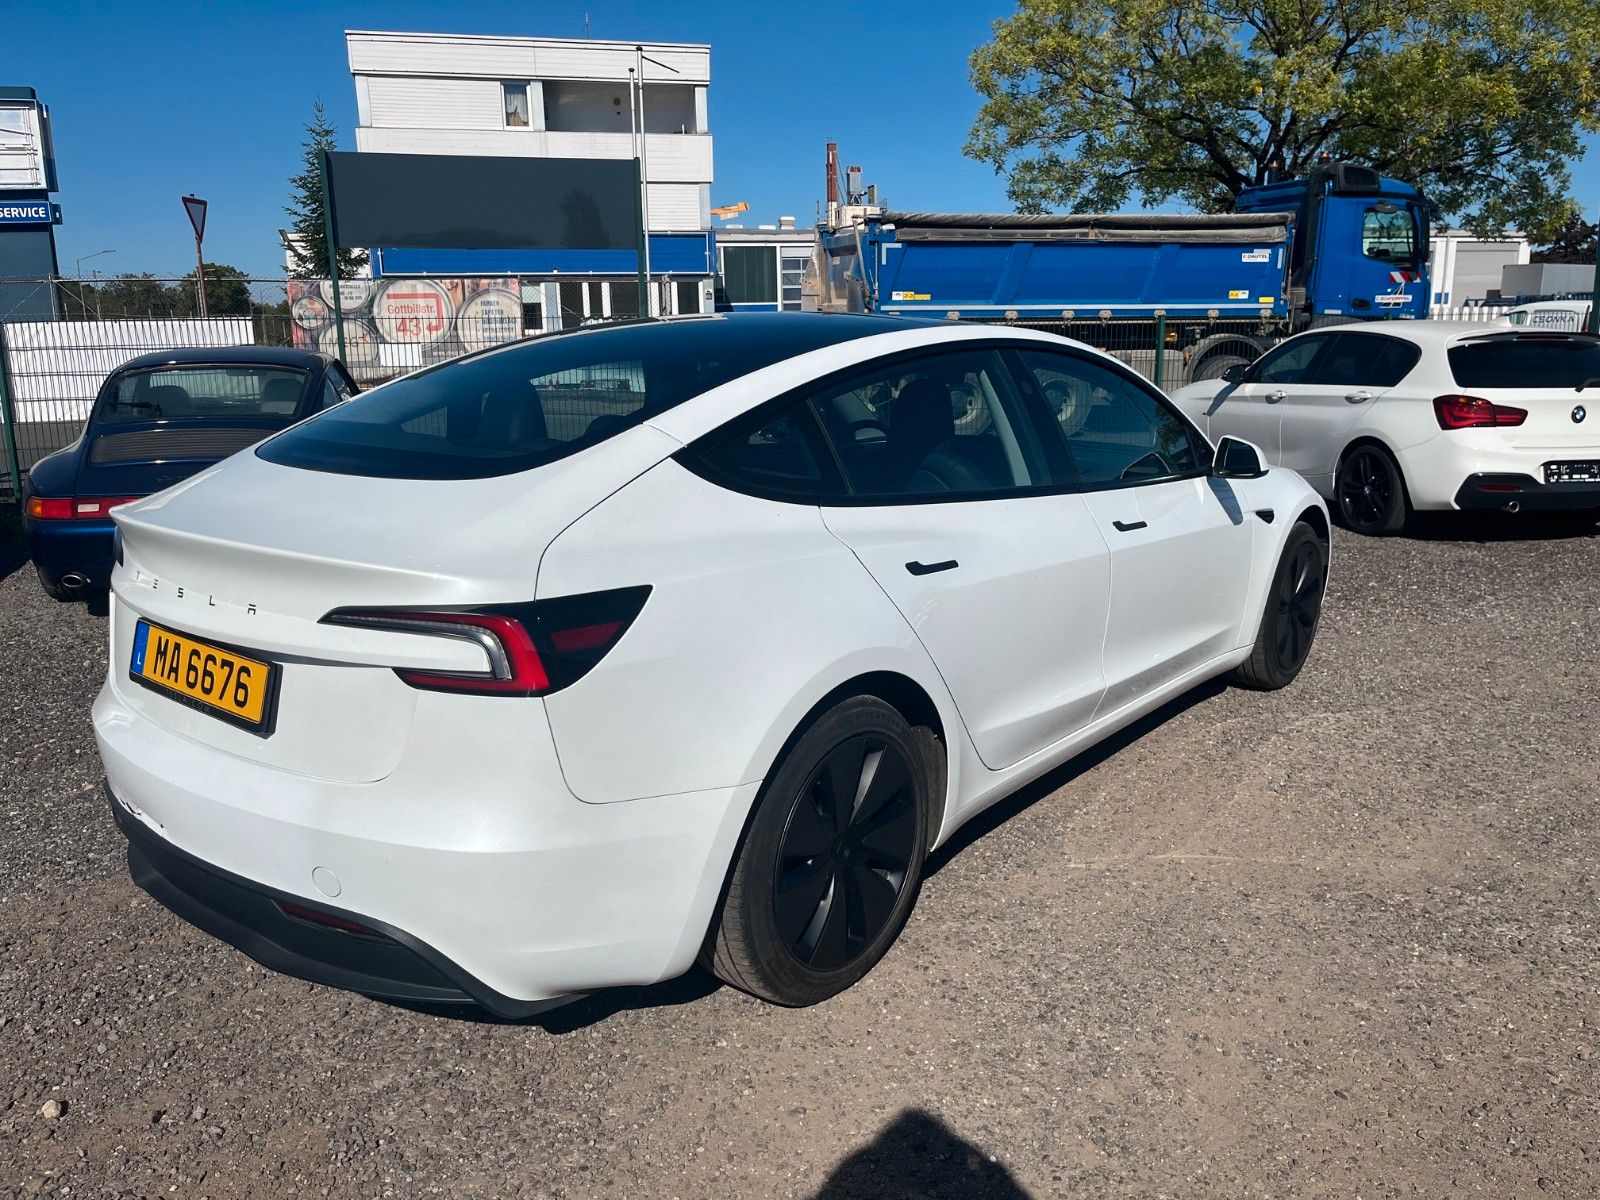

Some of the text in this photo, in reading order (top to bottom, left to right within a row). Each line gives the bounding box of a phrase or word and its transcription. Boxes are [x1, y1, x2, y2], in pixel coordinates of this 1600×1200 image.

[387, 303, 436, 315] Gottbillstr.
[396, 317, 422, 336] 43
[136, 570, 257, 616] TESLA
[153, 635, 252, 708] MA 6676
